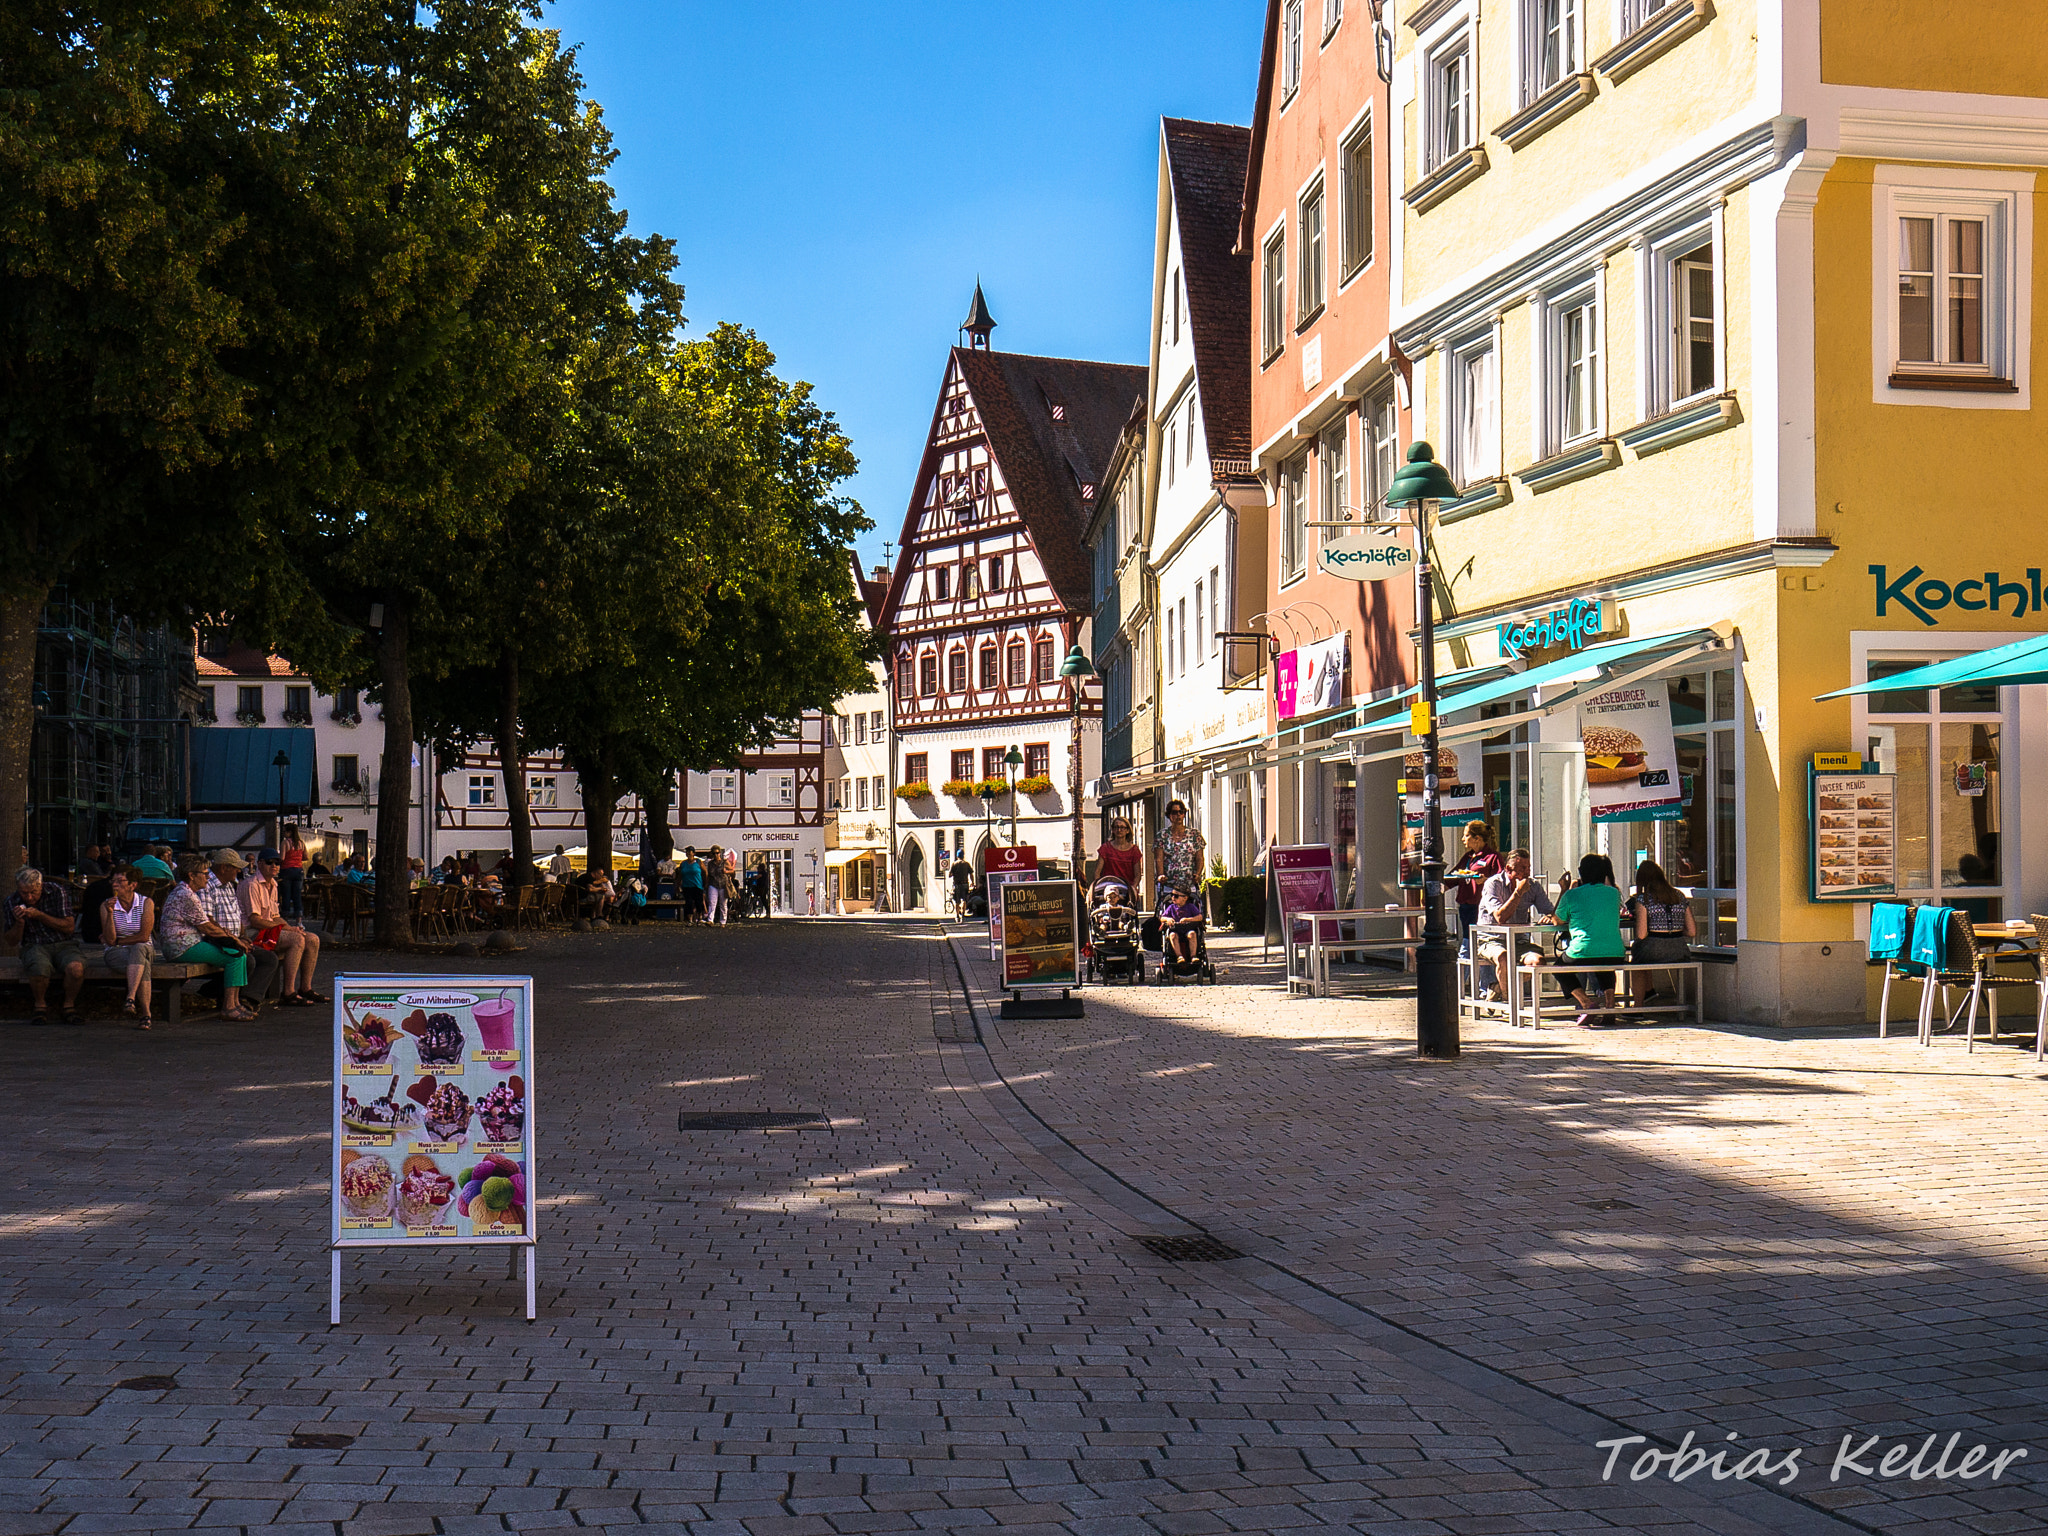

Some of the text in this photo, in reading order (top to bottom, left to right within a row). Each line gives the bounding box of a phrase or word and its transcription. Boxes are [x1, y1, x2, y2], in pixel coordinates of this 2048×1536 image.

[1323, 545, 1412, 567] Kochlöffel
[1868, 564, 2048, 626] Kochl
[1496, 598, 1603, 661] Kochlöffel
[1586, 706, 1597, 714] MIT
[1820, 755, 1848, 765] menü
[1819, 780, 1866, 793] UNSERE MENÜS
[1595, 799, 1665, 817] So geht lecker!
[742, 833, 799, 841] OPTIK SCHIERLE
[998, 861, 1026, 869] vodafone
[1007, 889, 1038, 903] 100 %
[406, 995, 471, 1004] Zum Mitnehmen
[371, 1134, 386, 1142] Split
